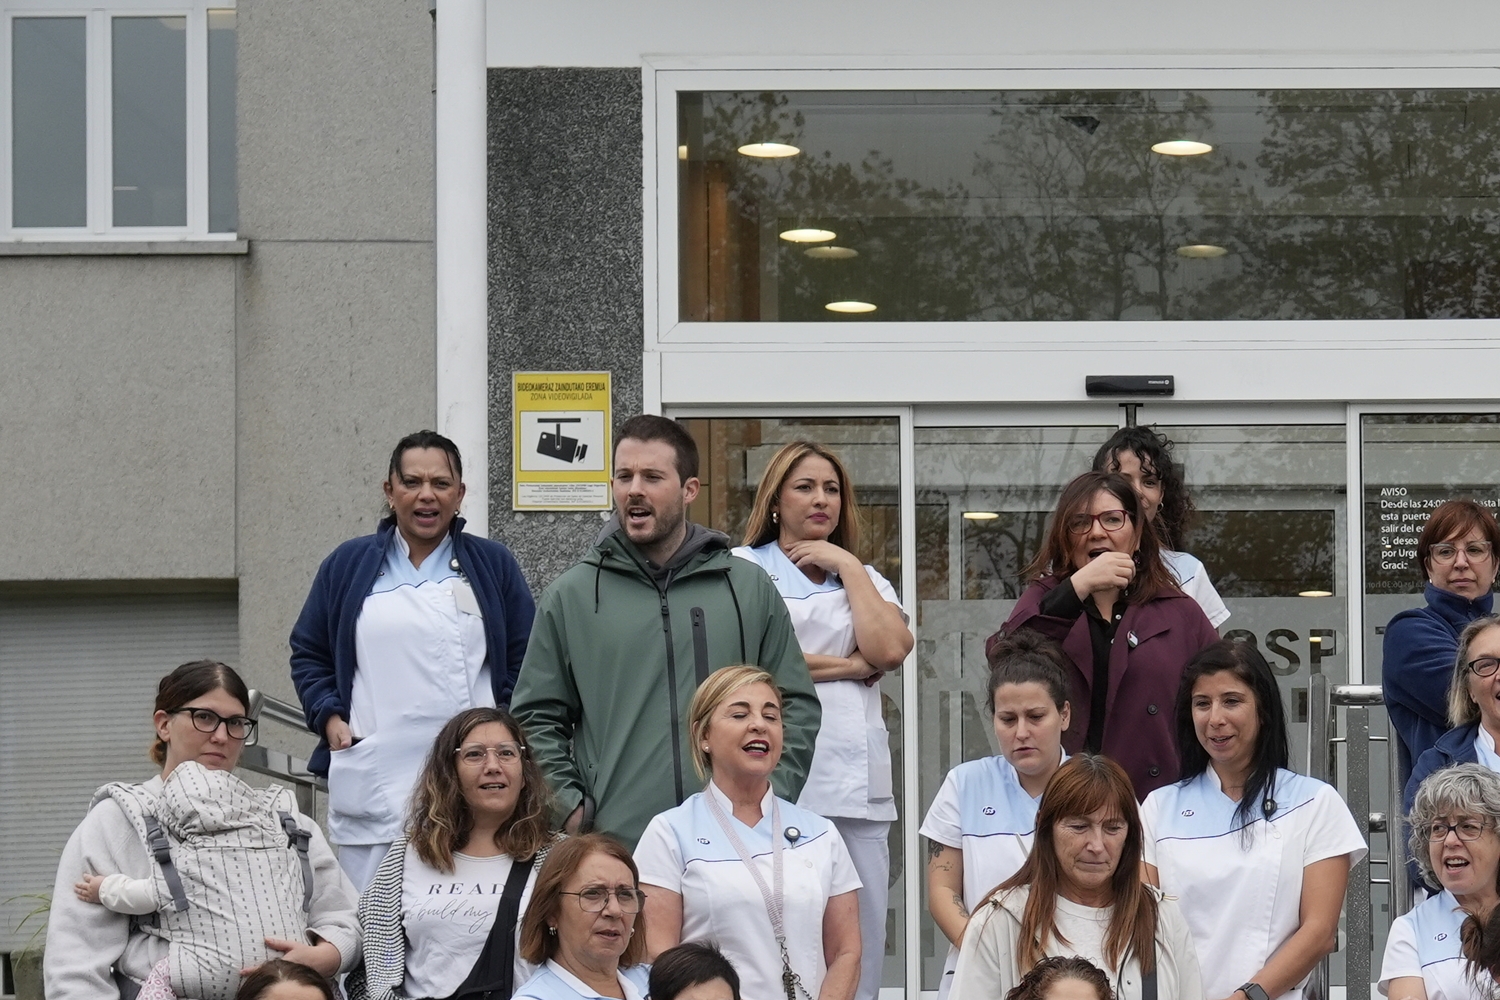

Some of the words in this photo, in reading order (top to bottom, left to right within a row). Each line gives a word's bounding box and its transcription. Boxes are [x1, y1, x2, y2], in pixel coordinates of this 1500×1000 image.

[517, 382, 554, 391] BIDEOKAMERAZ
[555, 382, 585, 391] ZAINDUTAKO
[585, 382, 606, 391] EREMUA
[530, 392, 547, 401] ZONA
[548, 392, 593, 401] VIDEOVIGILADA
[1380, 487, 1408, 496] AVISO
[1380, 499, 1408, 509] Desde
[1409, 499, 1422, 509] las
[1380, 513, 1399, 521] esta
[1402, 513, 1431, 522] puerta
[1381, 524, 1399, 533] salir
[1400, 524, 1414, 533] del
[1381, 536, 1390, 545] Si
[1393, 536, 1419, 545] desea
[1381, 550, 1397, 559] por
[426, 882, 528, 896] READ
